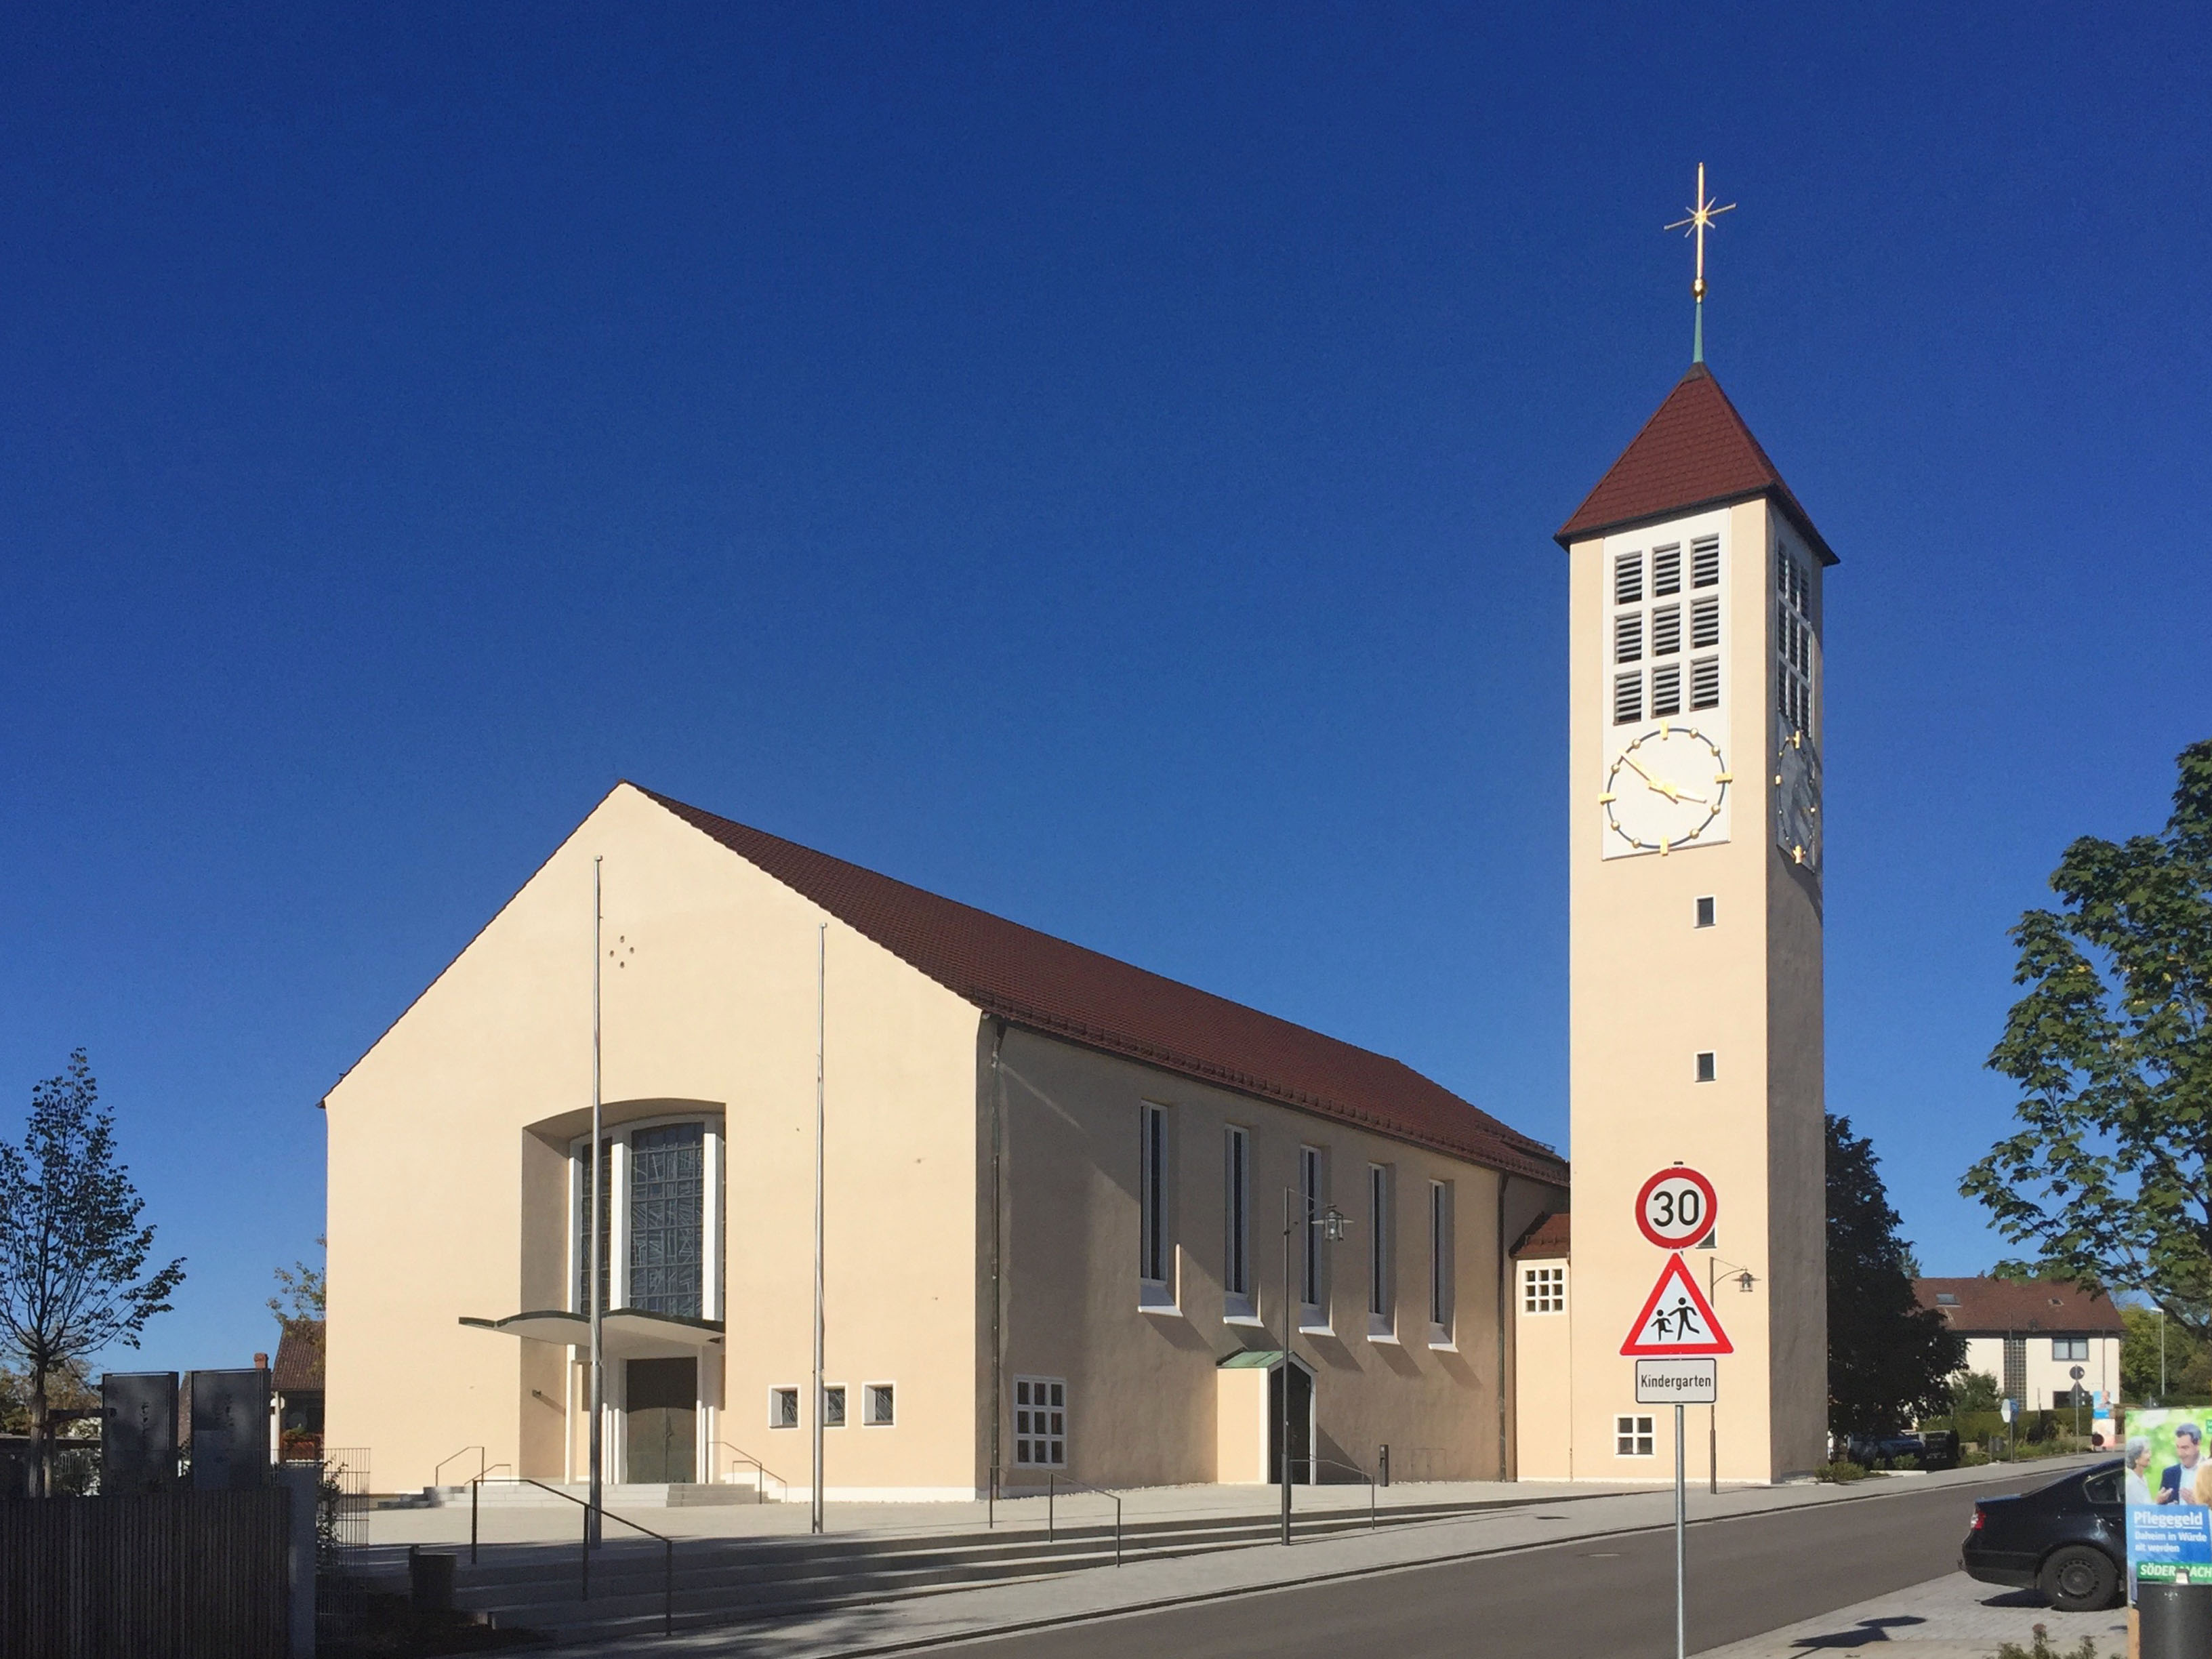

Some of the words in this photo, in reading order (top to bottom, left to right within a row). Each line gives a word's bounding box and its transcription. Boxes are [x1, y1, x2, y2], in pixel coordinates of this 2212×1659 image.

[1653, 1189, 1699, 1227] 30
[1641, 1374, 1711, 1391] Kindergarten
[2134, 1511, 2203, 1528] Pflegegeld
[2135, 1531, 2166, 1540] Daheim
[2168, 1532, 2177, 1540] in
[2178, 1532, 2207, 1542] Würde
[2148, 1543, 2180, 1553] werden
[2140, 1562, 2176, 1576] SÖDER
[2179, 1565, 2212, 1578] ACH
